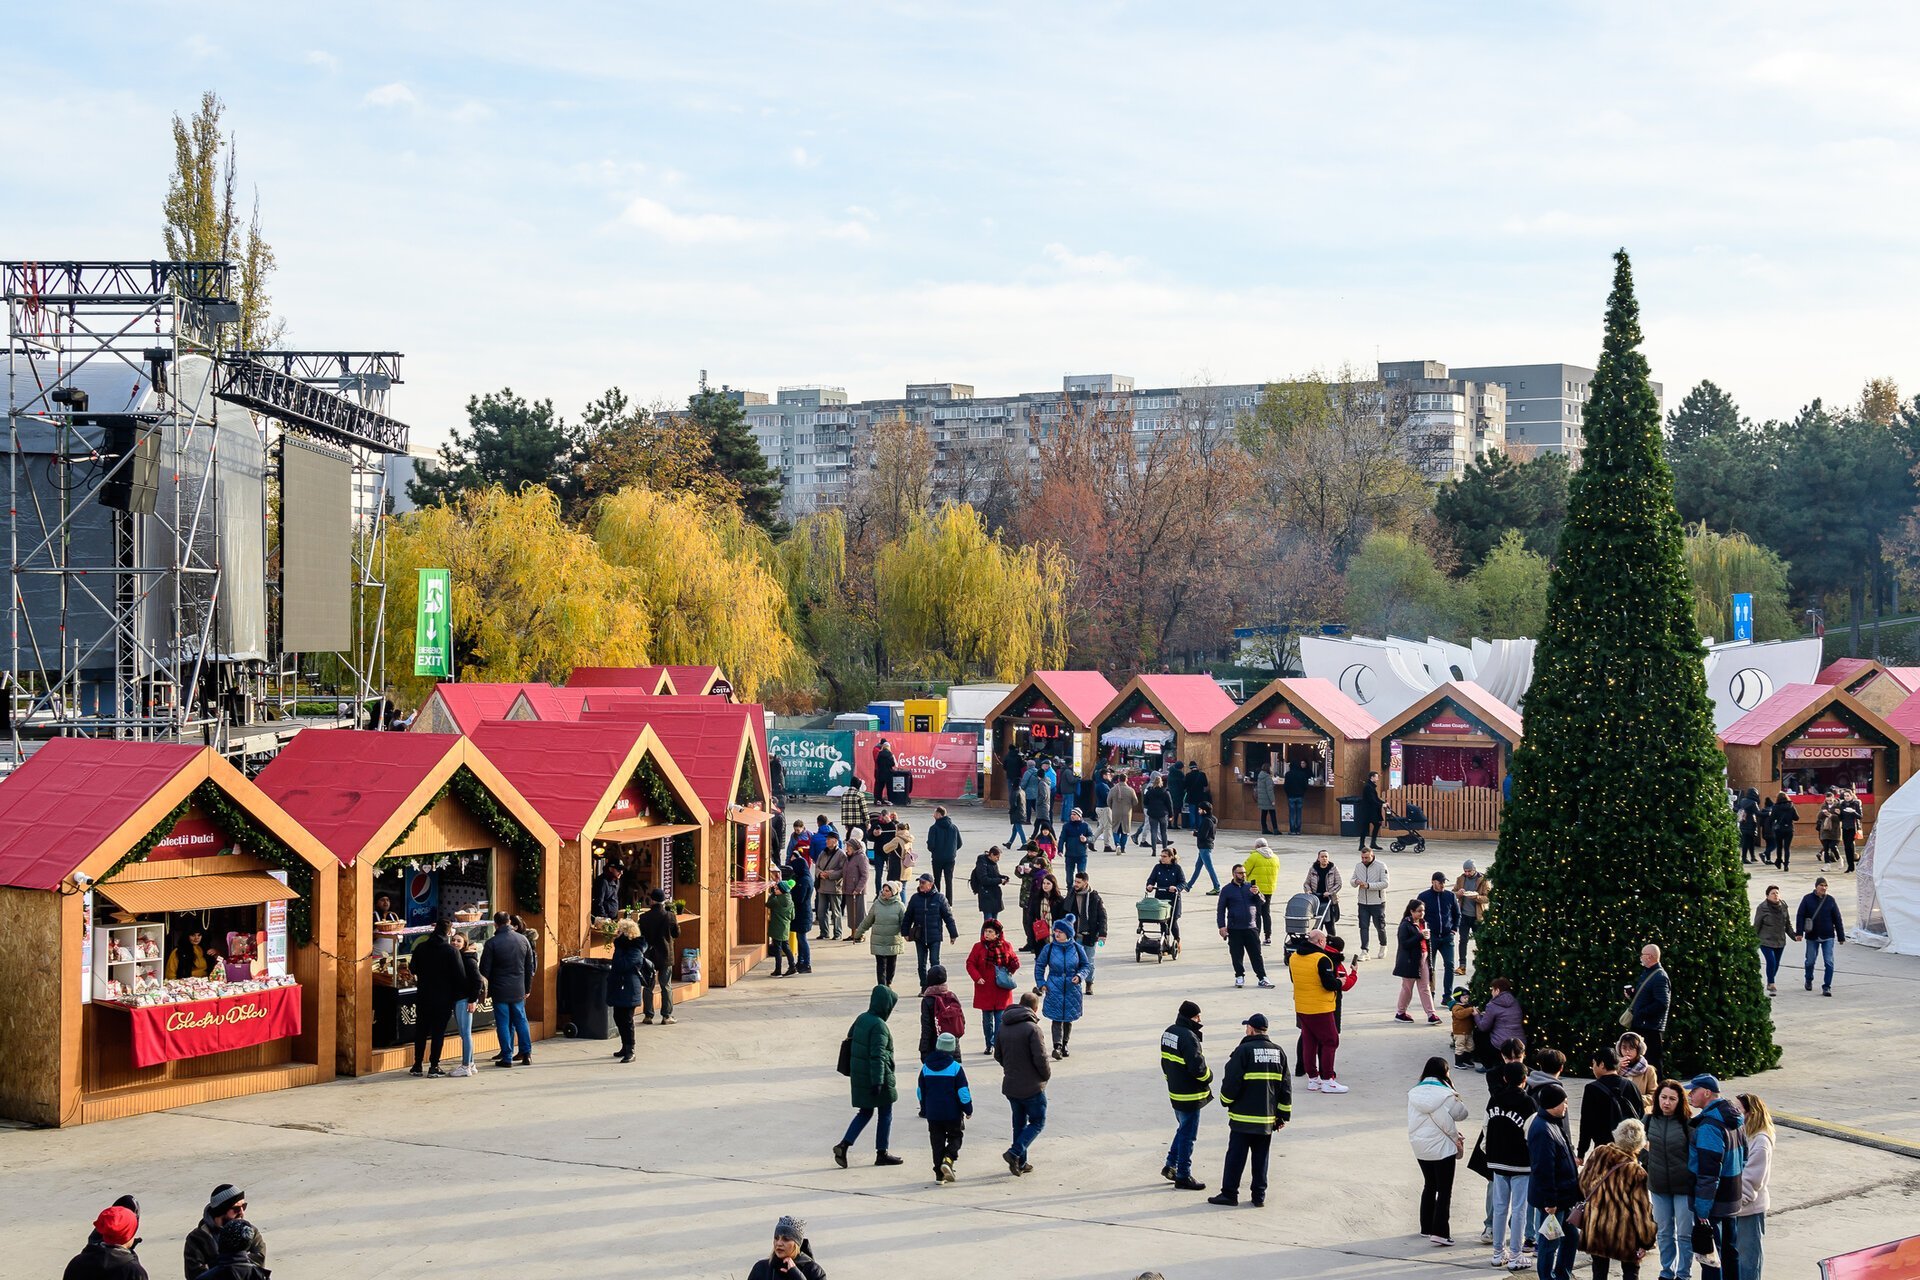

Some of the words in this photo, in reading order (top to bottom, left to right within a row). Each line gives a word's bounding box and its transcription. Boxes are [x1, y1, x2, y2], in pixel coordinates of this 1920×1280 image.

[418, 655, 443, 666] EXIT
[799, 740, 843, 761] Side
[780, 760, 824, 768] RISTMAS
[917, 755, 947, 770] Side
[616, 799, 629, 810] BAR
[158, 834, 189, 847] olecții
[190, 832, 214, 844] Dulci
